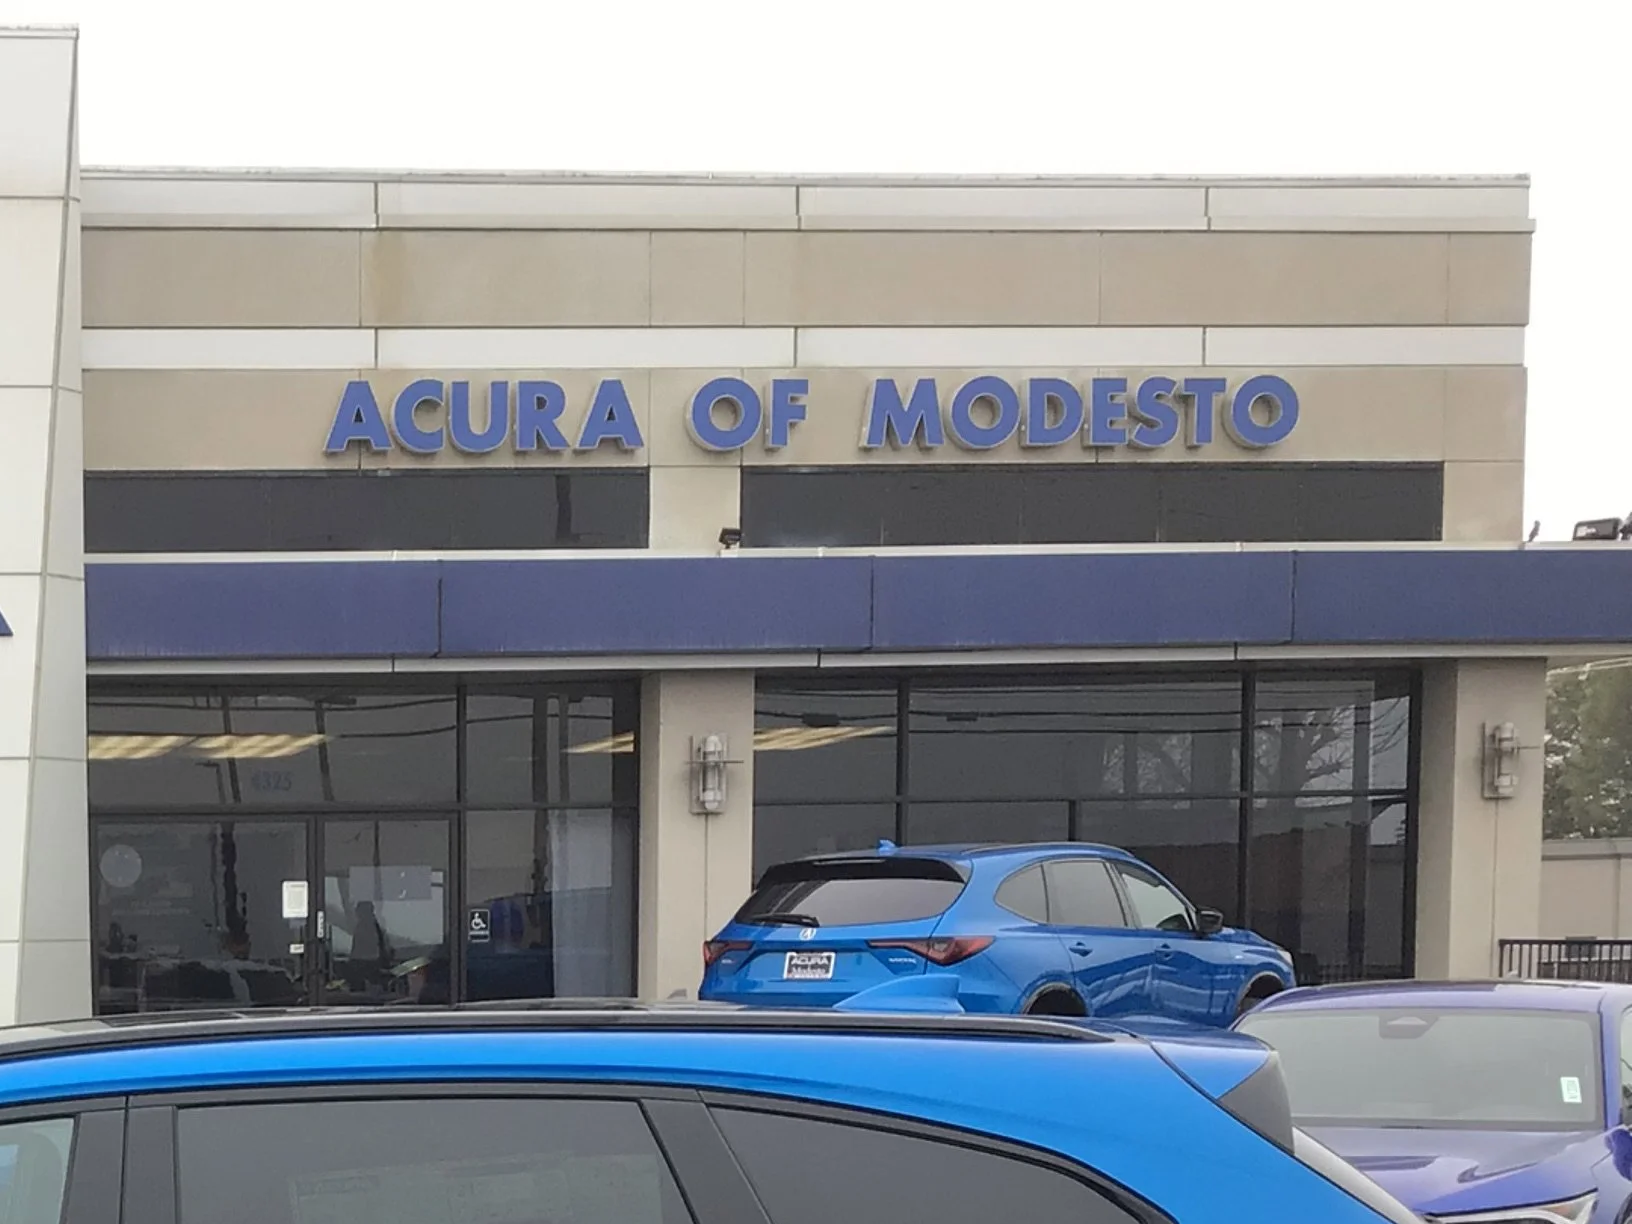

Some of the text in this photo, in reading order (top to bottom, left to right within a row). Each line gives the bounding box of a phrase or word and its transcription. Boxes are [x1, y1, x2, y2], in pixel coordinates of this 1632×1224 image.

[323, 374, 1299, 454] ACURA OF MODESTO
[791, 957, 829, 965] ACURA
